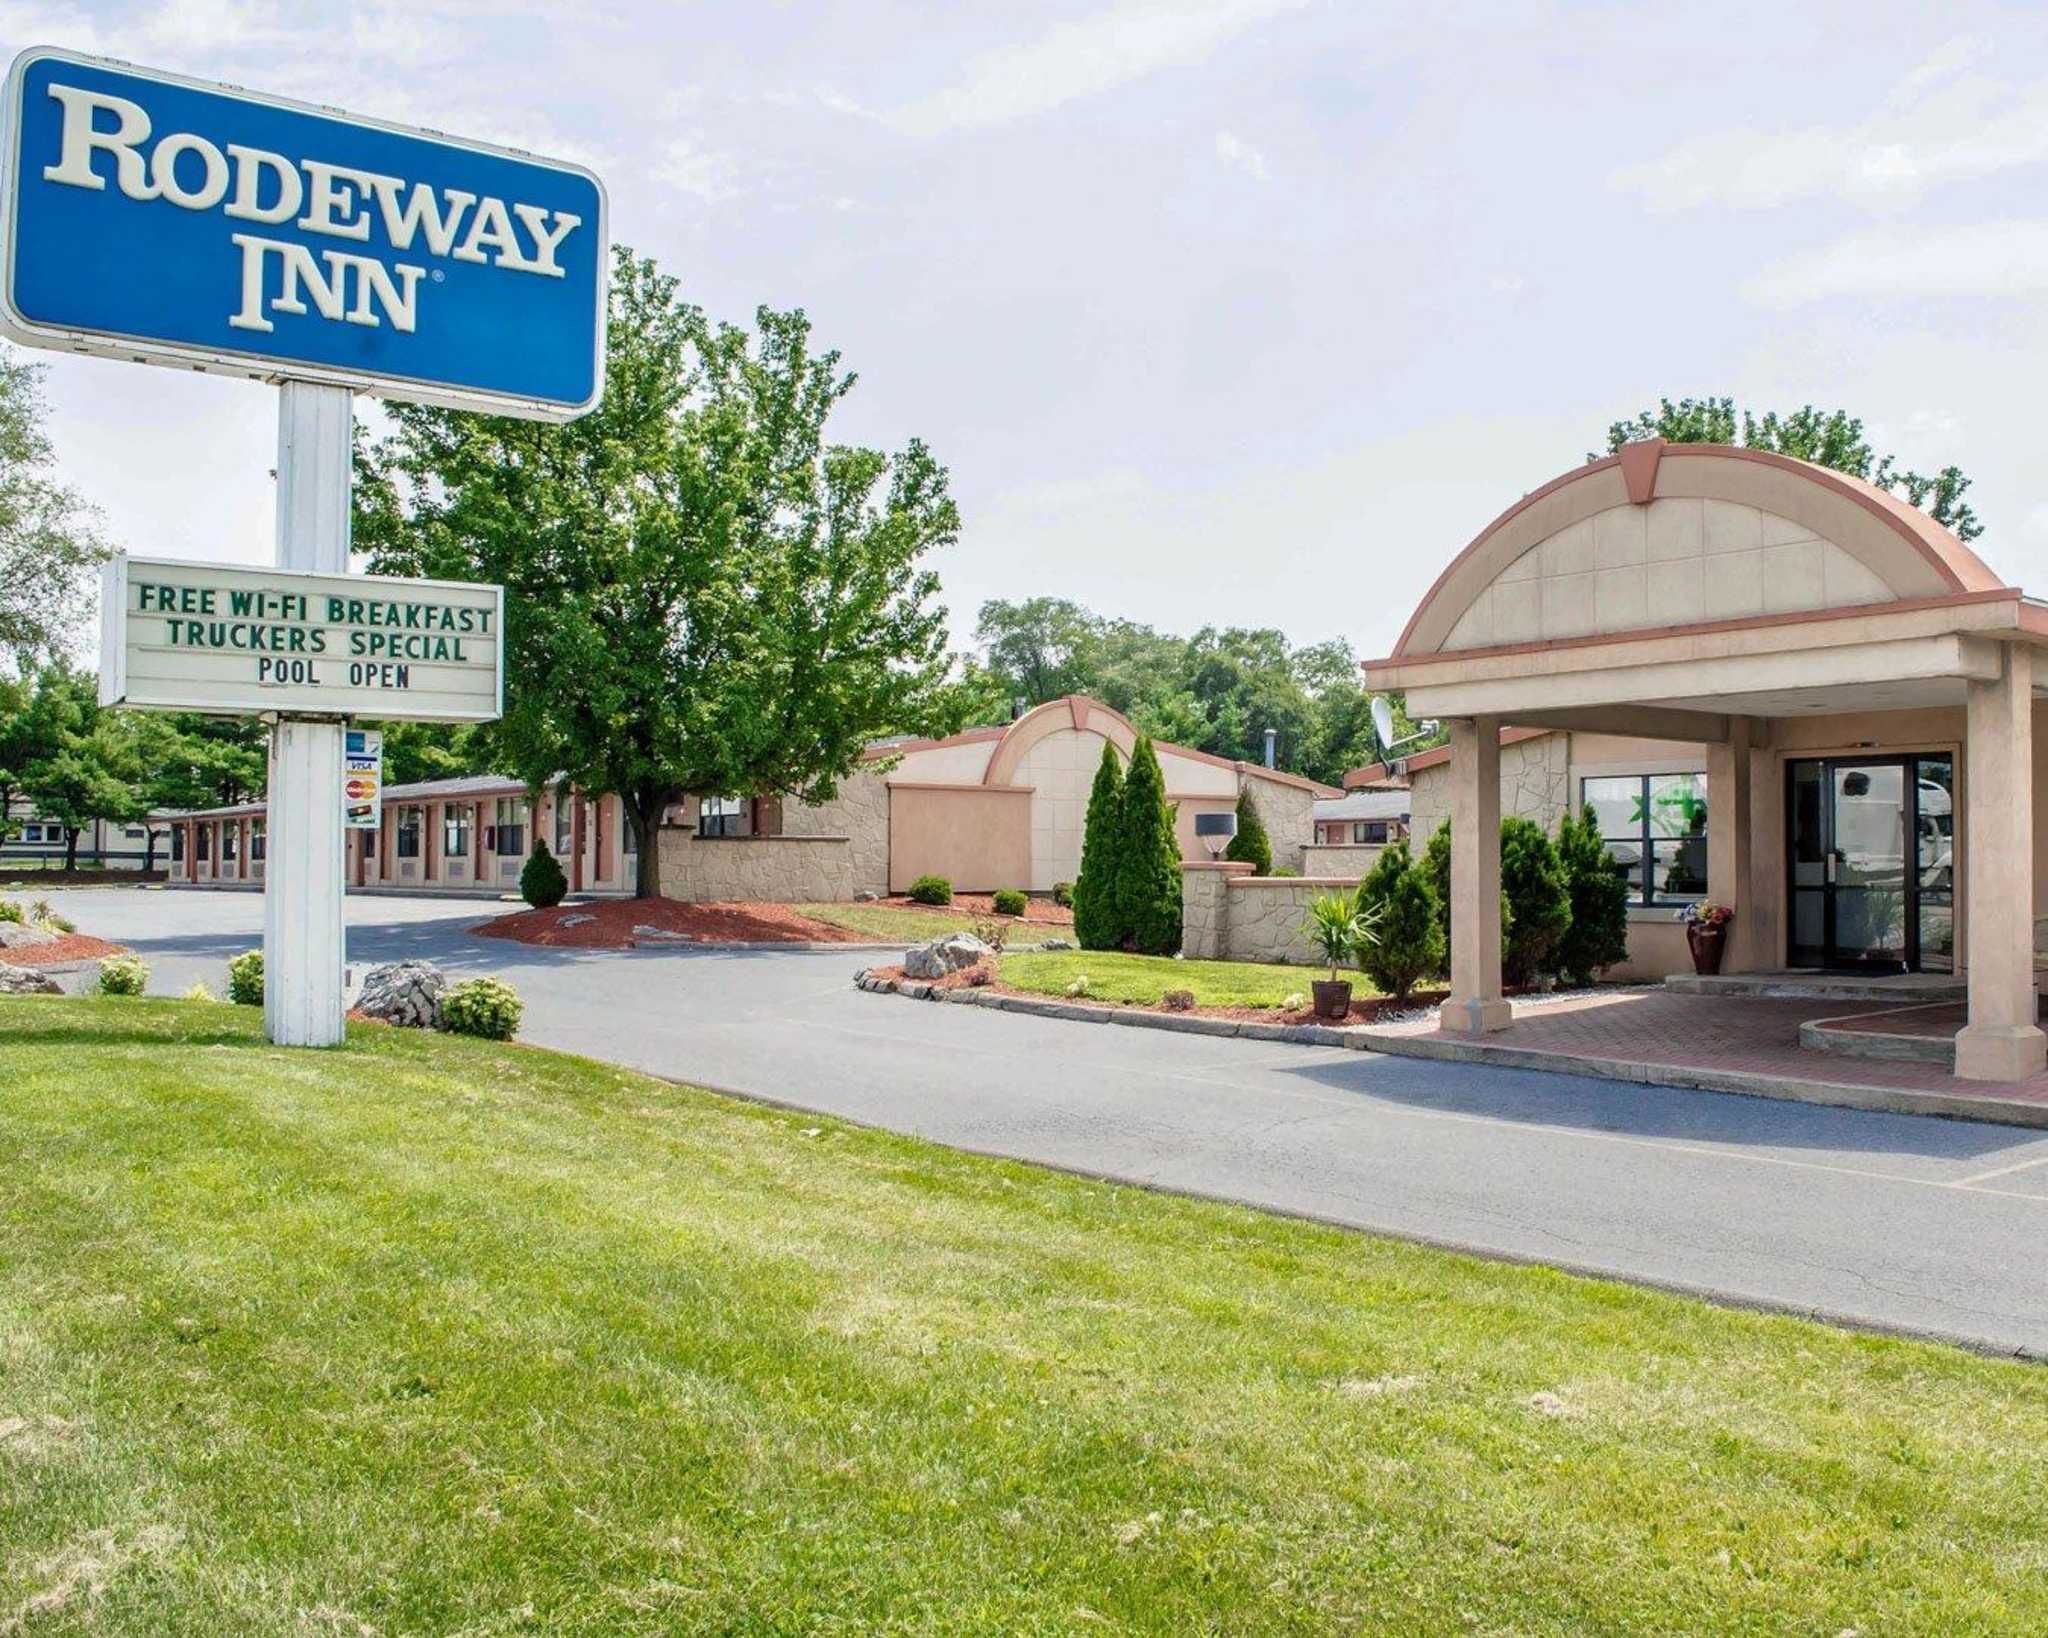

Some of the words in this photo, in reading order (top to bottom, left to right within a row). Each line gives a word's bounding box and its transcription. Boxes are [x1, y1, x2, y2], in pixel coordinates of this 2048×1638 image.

[43, 83, 581, 278] RODEWAY
[229, 233, 426, 333] INN
[139, 585, 216, 615] FREE
[230, 591, 307, 621] WI-FI
[328, 598, 492, 634] BREAKFAST
[167, 619, 326, 654] TRUCKERS
[350, 631, 468, 662] SPECIAL
[258, 657, 321, 685] POOL
[349, 663, 410, 689] OPEN
[351, 762, 372, 770] VISA
